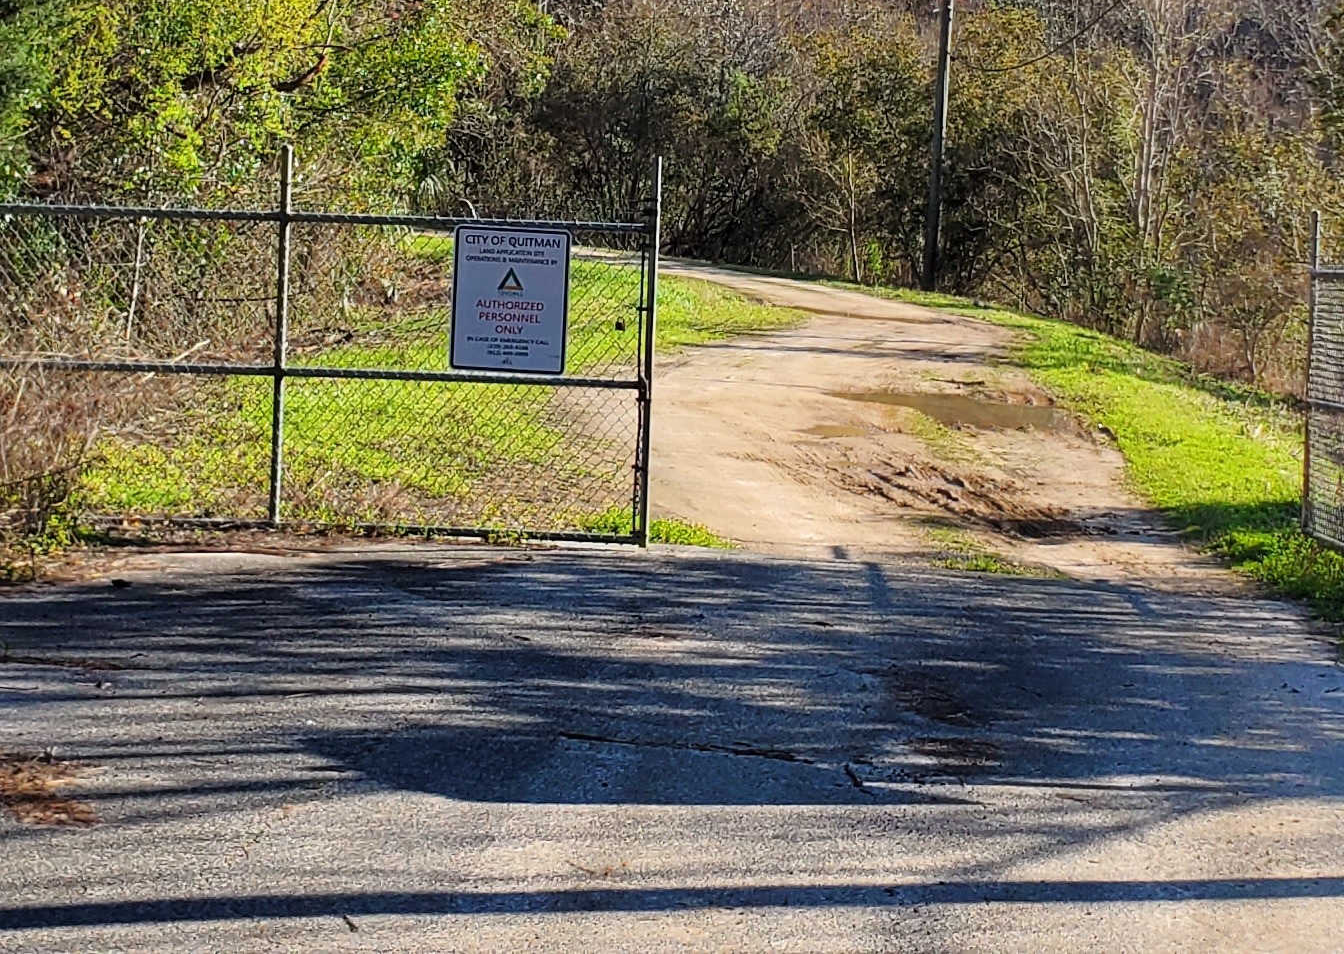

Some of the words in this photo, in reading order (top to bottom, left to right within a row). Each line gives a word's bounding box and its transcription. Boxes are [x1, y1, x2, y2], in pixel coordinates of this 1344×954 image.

[465, 234, 489, 245] CITY
[491, 235, 506, 246] OF
[508, 236, 561, 249] QUITMAN
[476, 299, 545, 312] AUTHORIZED
[479, 311, 541, 324] PERSONNEL
[495, 324, 524, 335] ONLY
